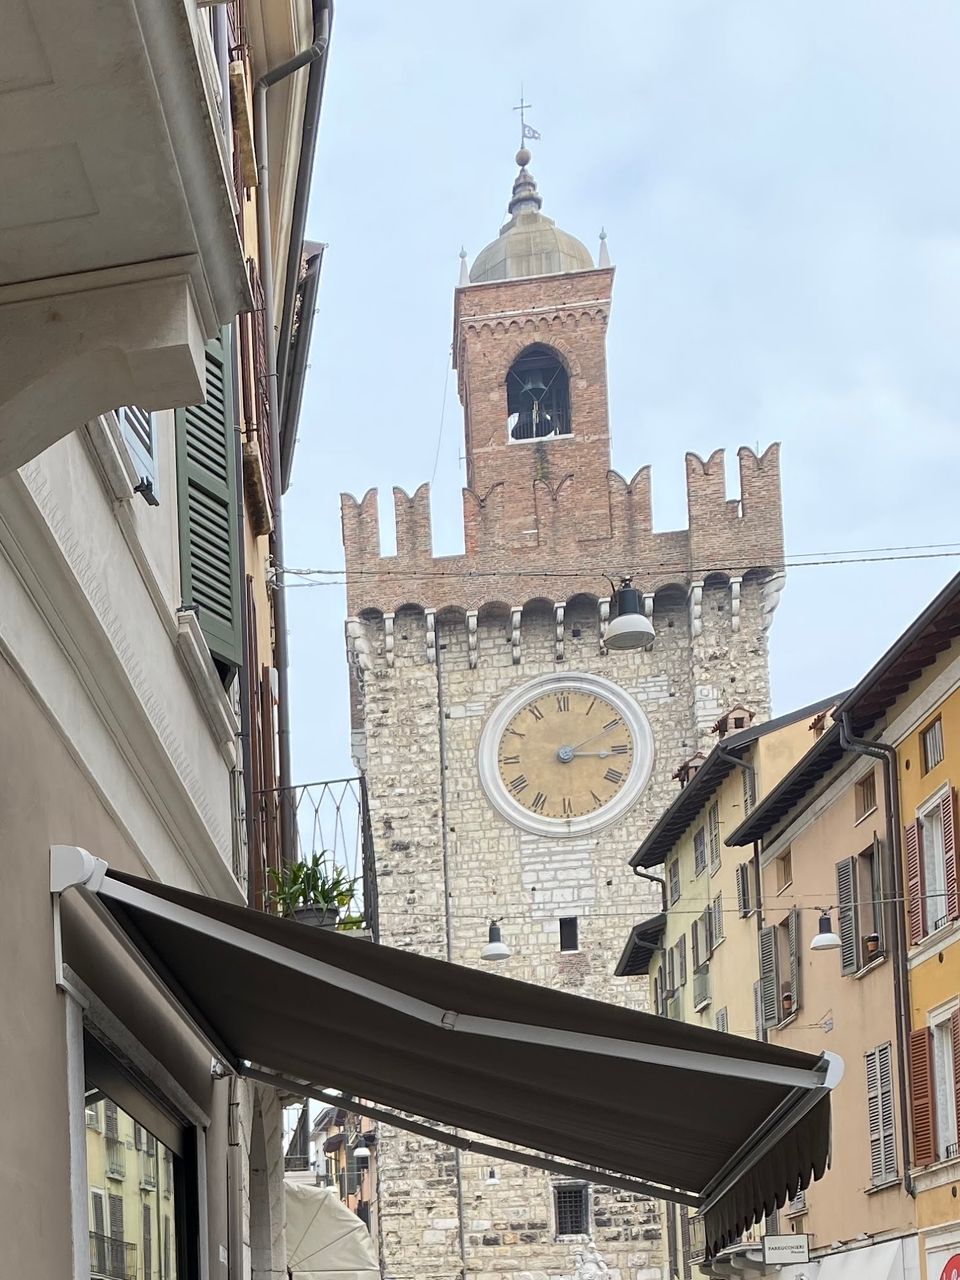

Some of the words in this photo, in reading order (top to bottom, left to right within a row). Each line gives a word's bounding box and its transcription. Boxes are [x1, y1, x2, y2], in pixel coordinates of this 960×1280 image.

[556, 695, 570, 712] XII
[529, 705, 544, 721] XI
[509, 728, 526, 738] X
